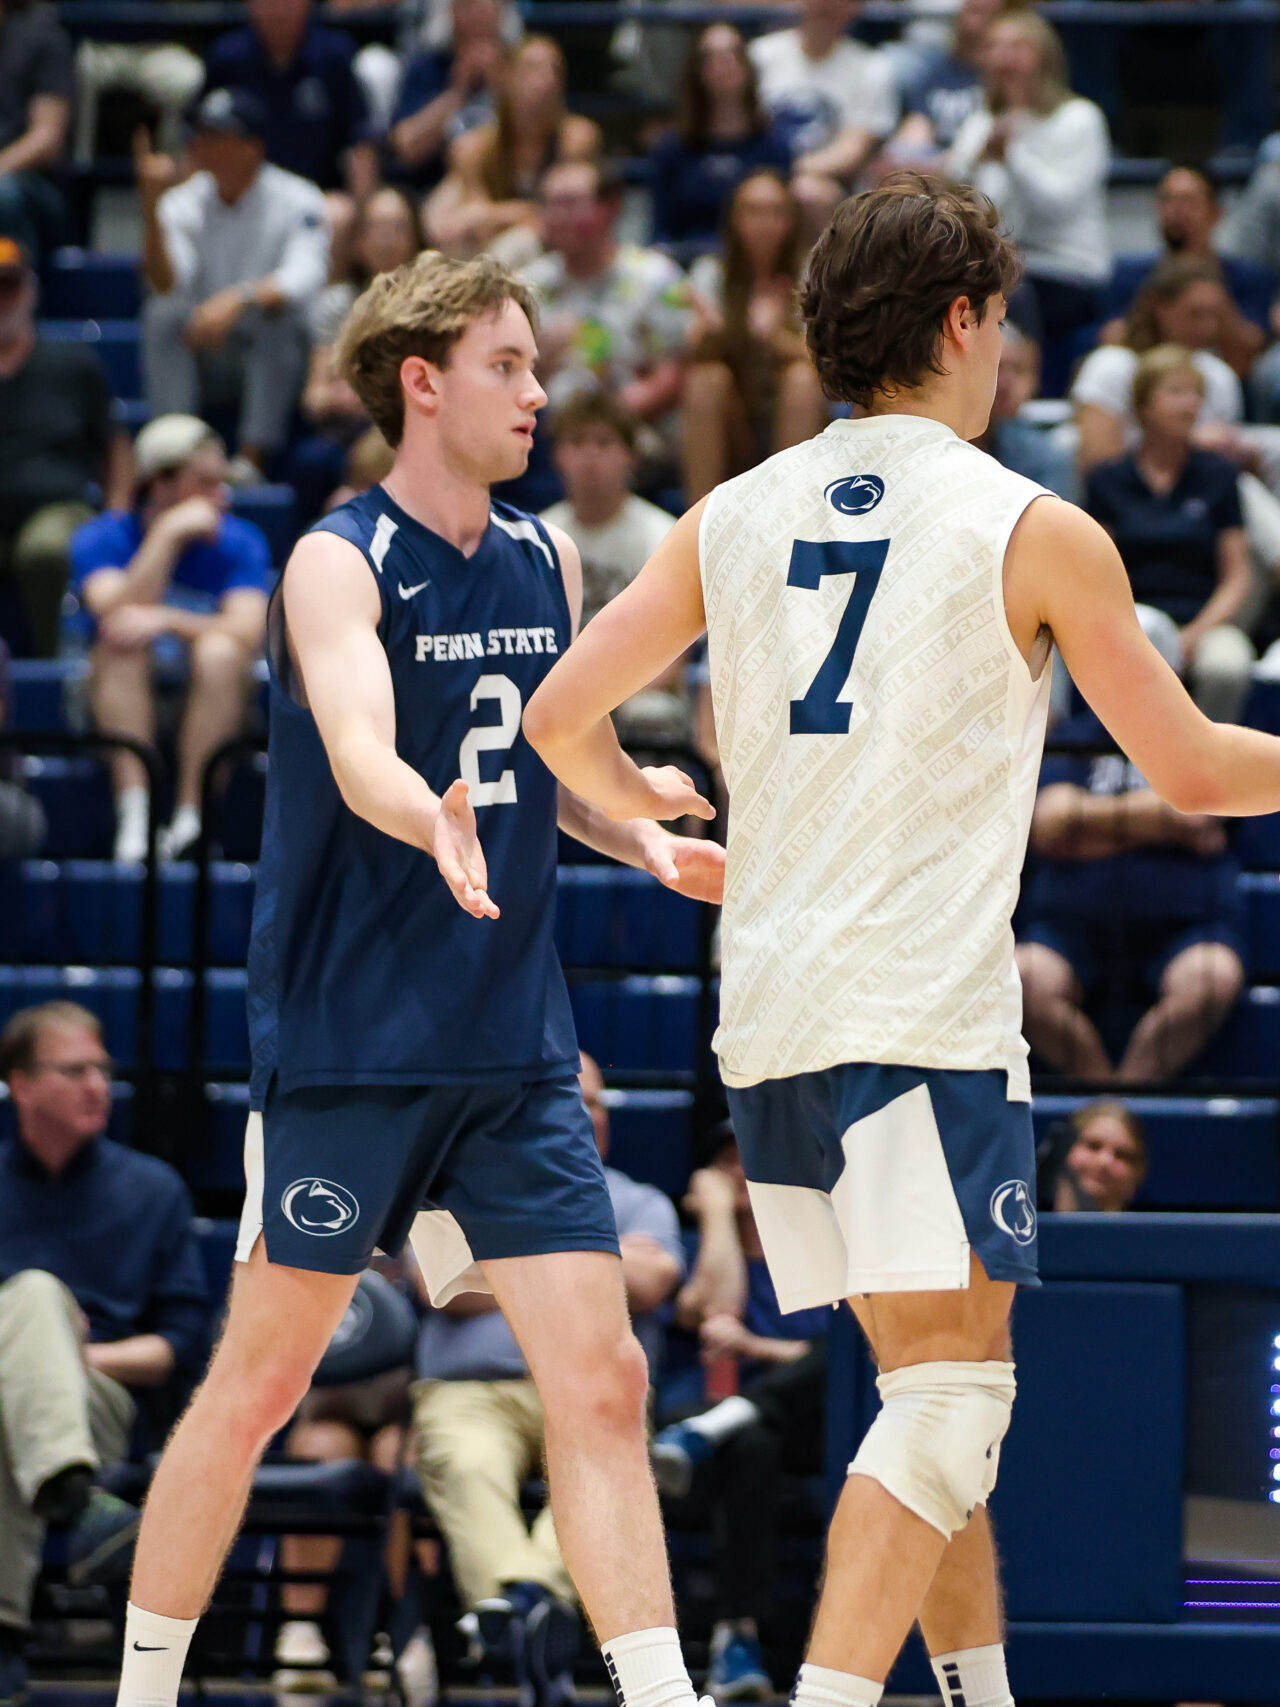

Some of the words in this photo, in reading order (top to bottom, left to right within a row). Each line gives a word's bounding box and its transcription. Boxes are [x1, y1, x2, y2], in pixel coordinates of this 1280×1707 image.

[415, 632, 485, 662] PENN
[486, 627, 558, 655] STATE
[786, 538, 891, 735] 7
[459, 673, 522, 807] 2
